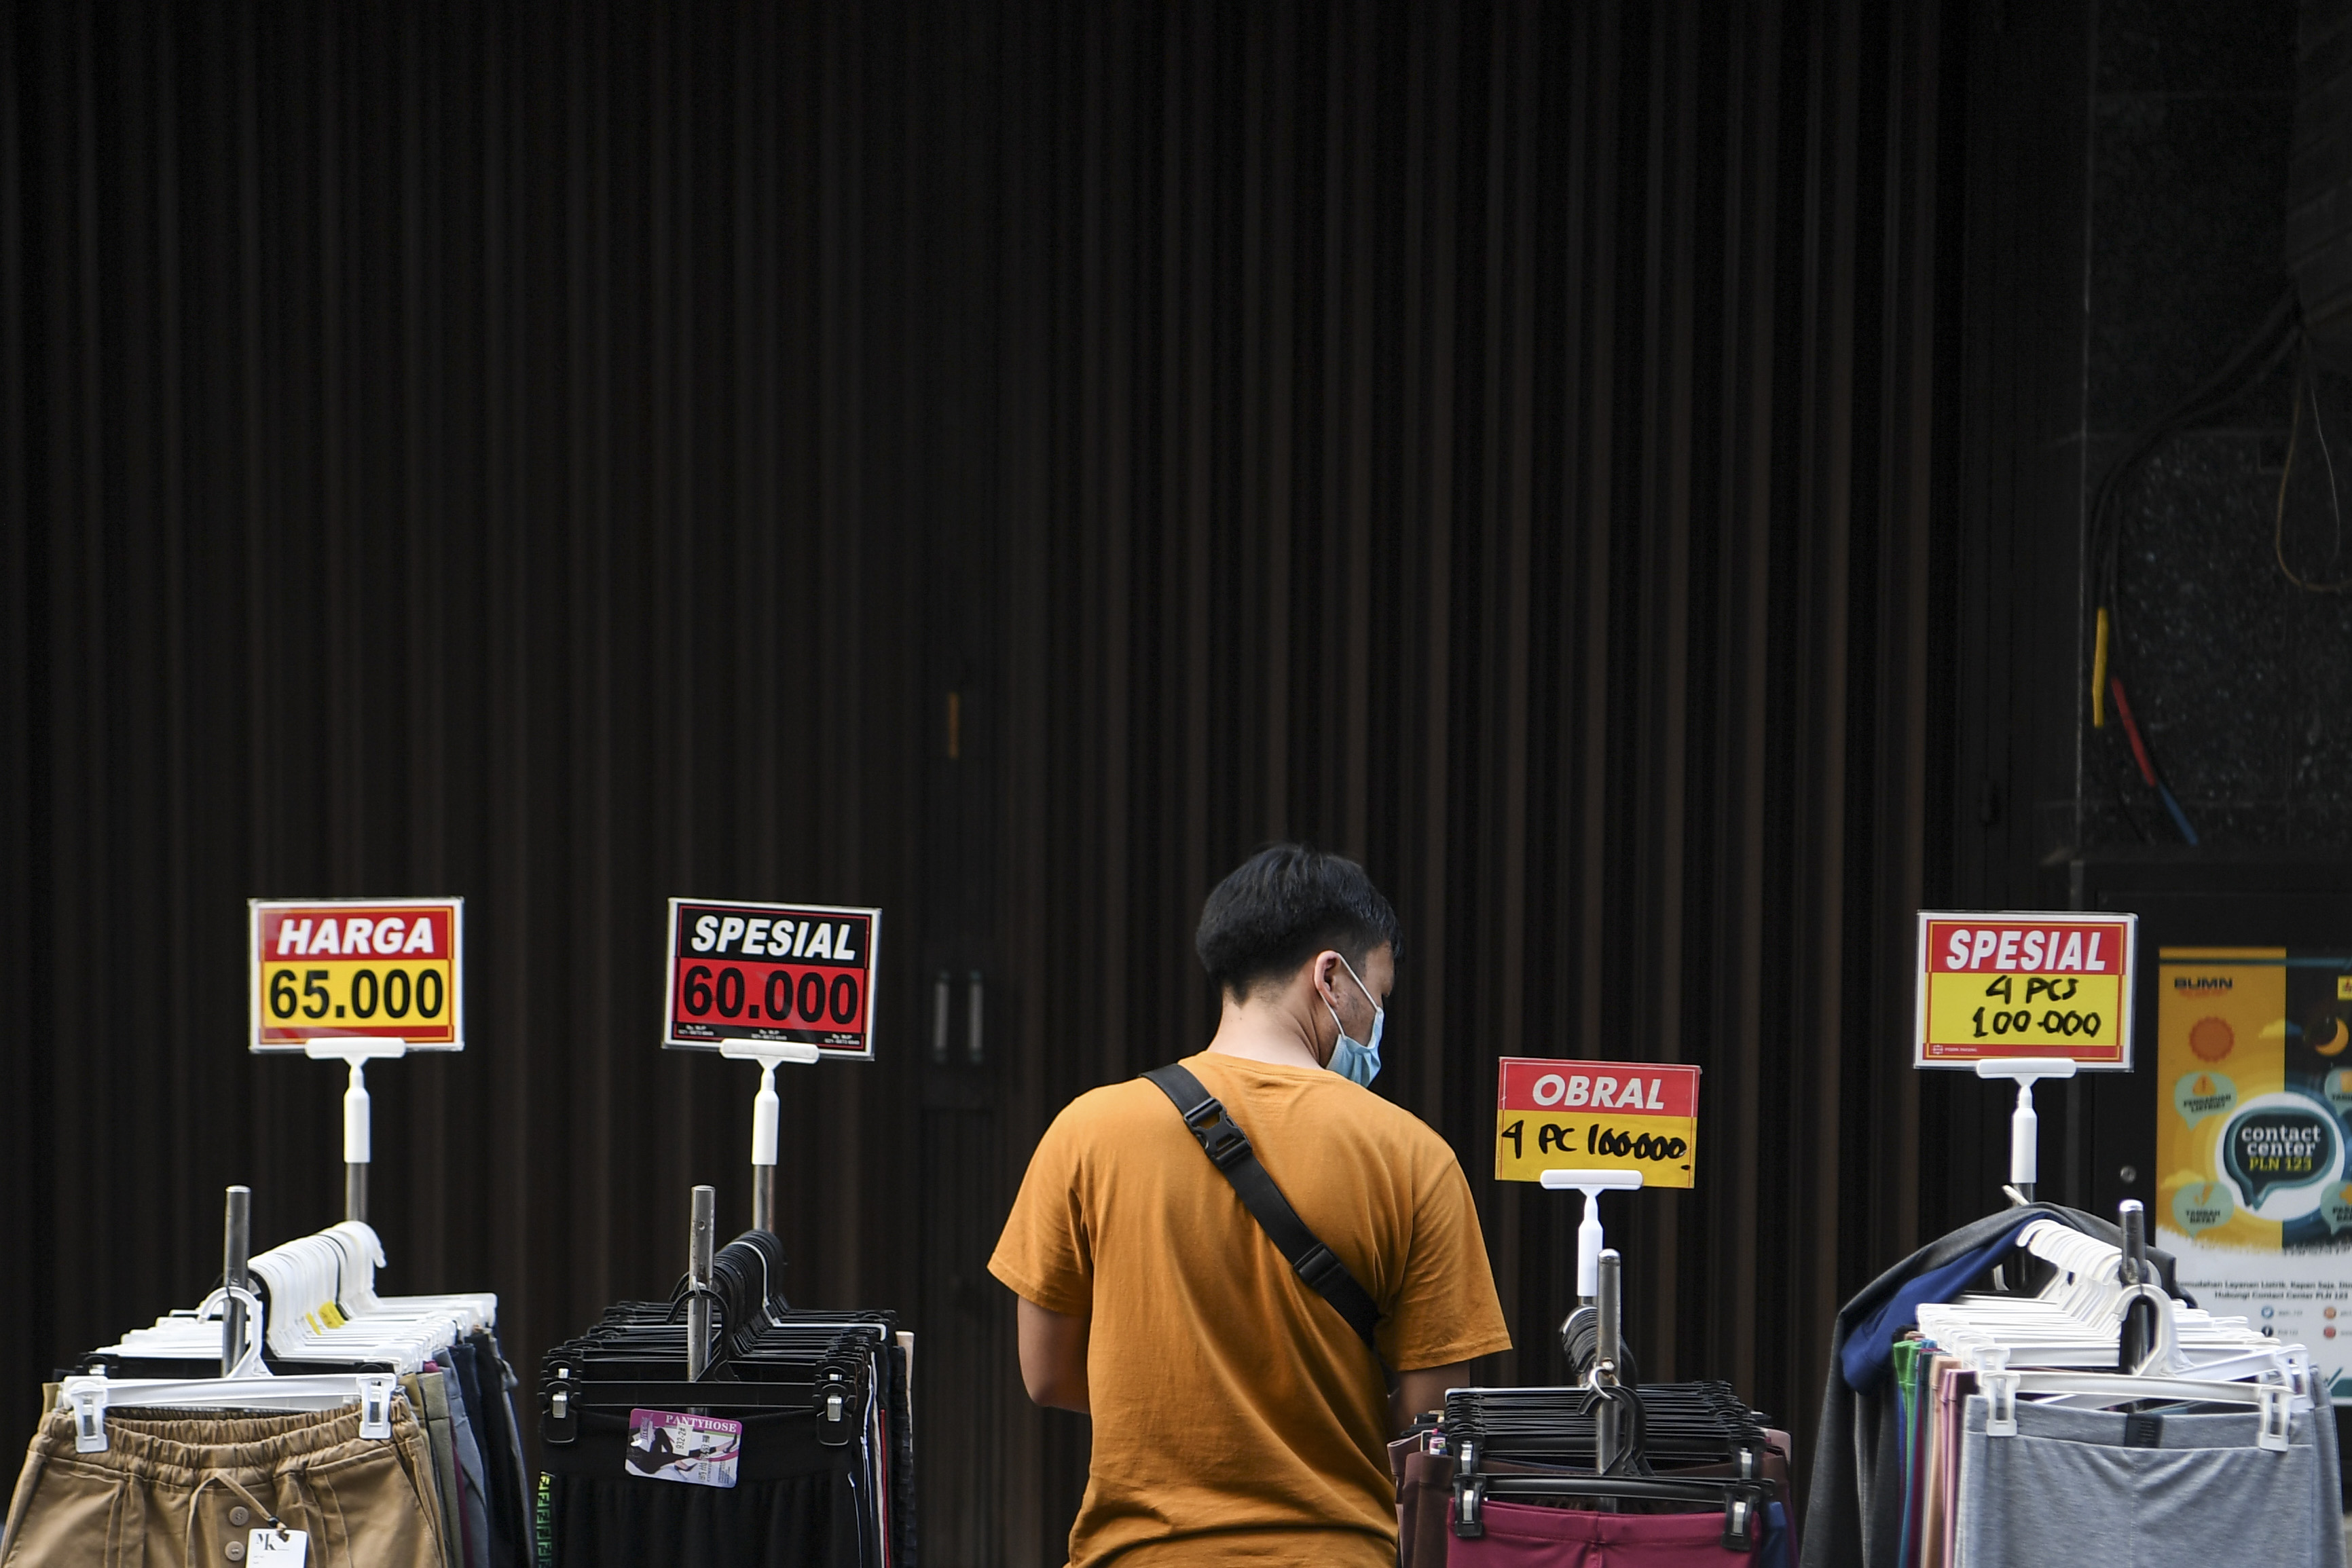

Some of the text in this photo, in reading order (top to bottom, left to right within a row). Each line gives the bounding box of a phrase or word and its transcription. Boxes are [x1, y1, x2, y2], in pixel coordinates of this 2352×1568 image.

[276, 916, 435, 955] HARGA
[691, 915, 856, 961] SPESIAL
[1945, 929, 2106, 971] SPESIAL
[270, 969, 444, 1019] 65.000
[683, 965, 858, 1025] 60.000
[1985, 975, 2013, 1005] 4
[2174, 977, 2233, 990] BUMN
[1532, 1074, 1664, 1109] OBRAL
[1501, 1119, 1524, 1159] 4
[1538, 1123, 1578, 1155] PC
[2241, 1125, 2321, 1143] contact
[2247, 1140, 2316, 1157] center
[2249, 1156, 2313, 1172] PLN 123
[665, 1414, 737, 1433] PANTYHOSE
